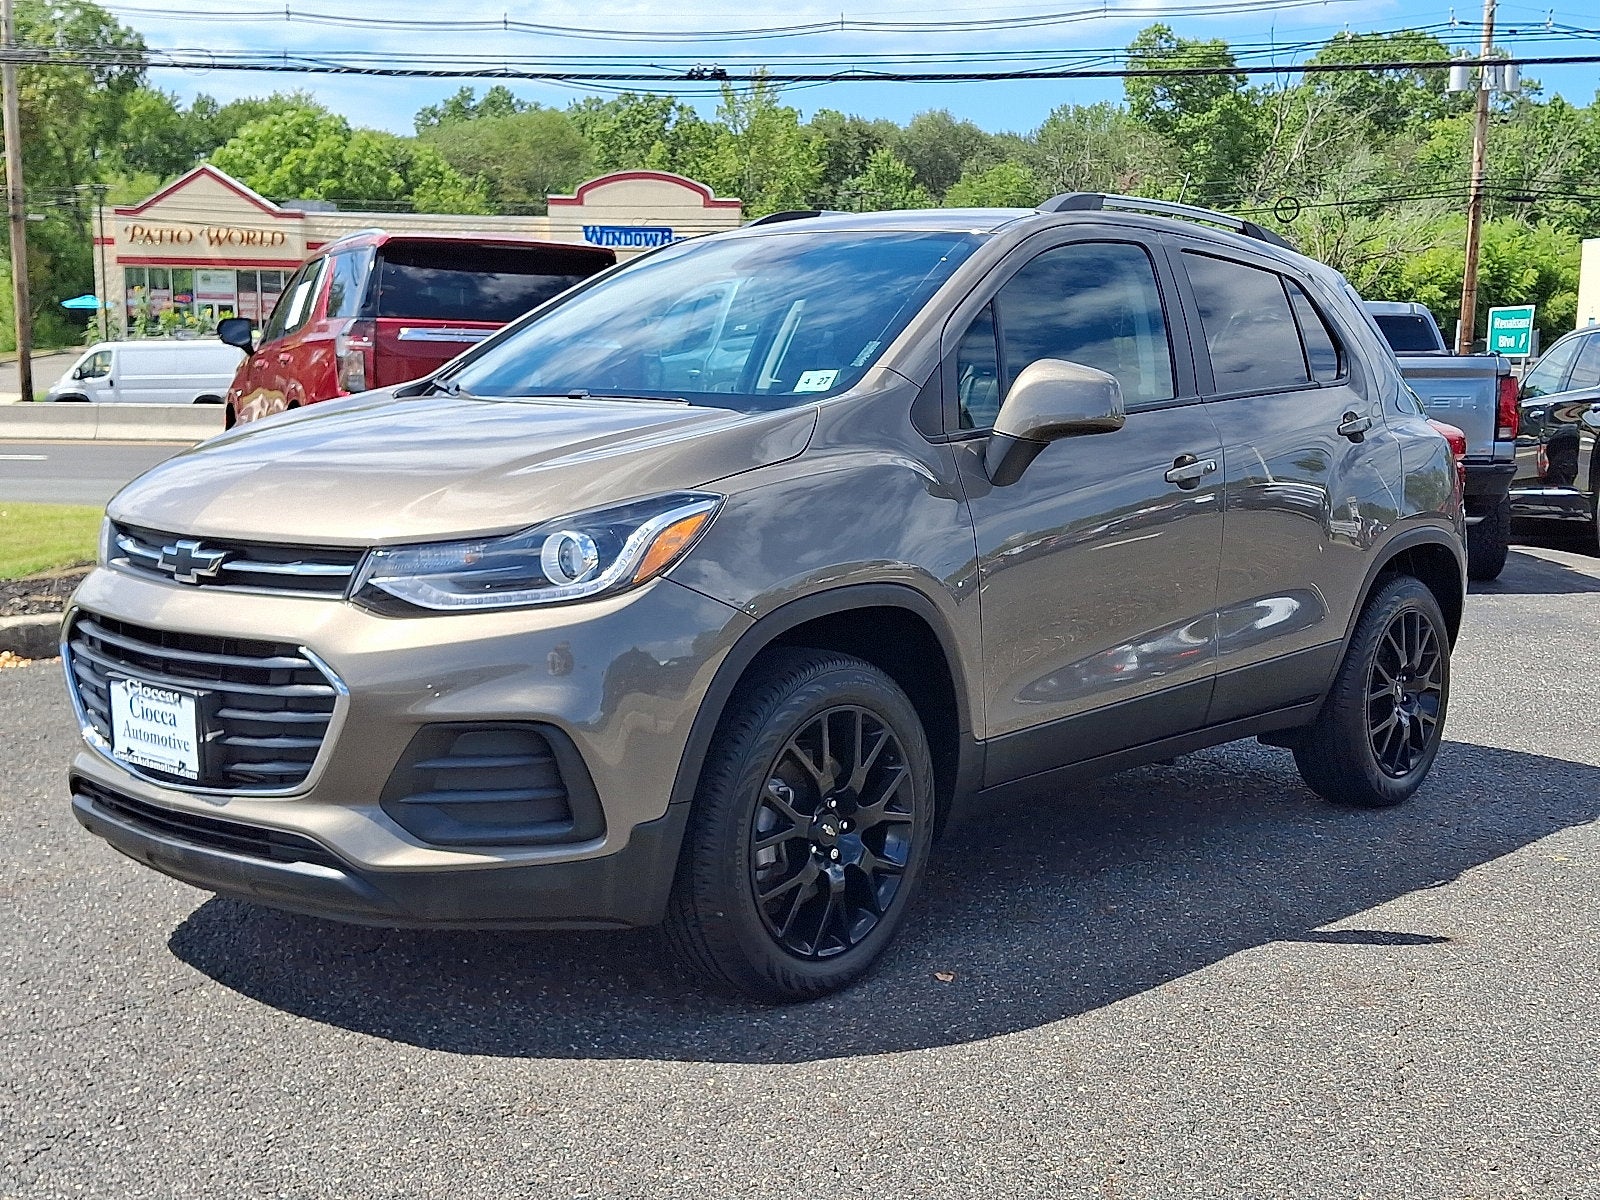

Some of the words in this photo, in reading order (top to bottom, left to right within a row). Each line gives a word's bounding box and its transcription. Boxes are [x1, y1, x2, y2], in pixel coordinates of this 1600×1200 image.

[125, 225, 193, 243] PATIO
[200, 226, 285, 245] WORLD
[1498, 335, 1516, 348] Blvd
[129, 695, 177, 727] Ciocca
[123, 719, 191, 753] Automotive
